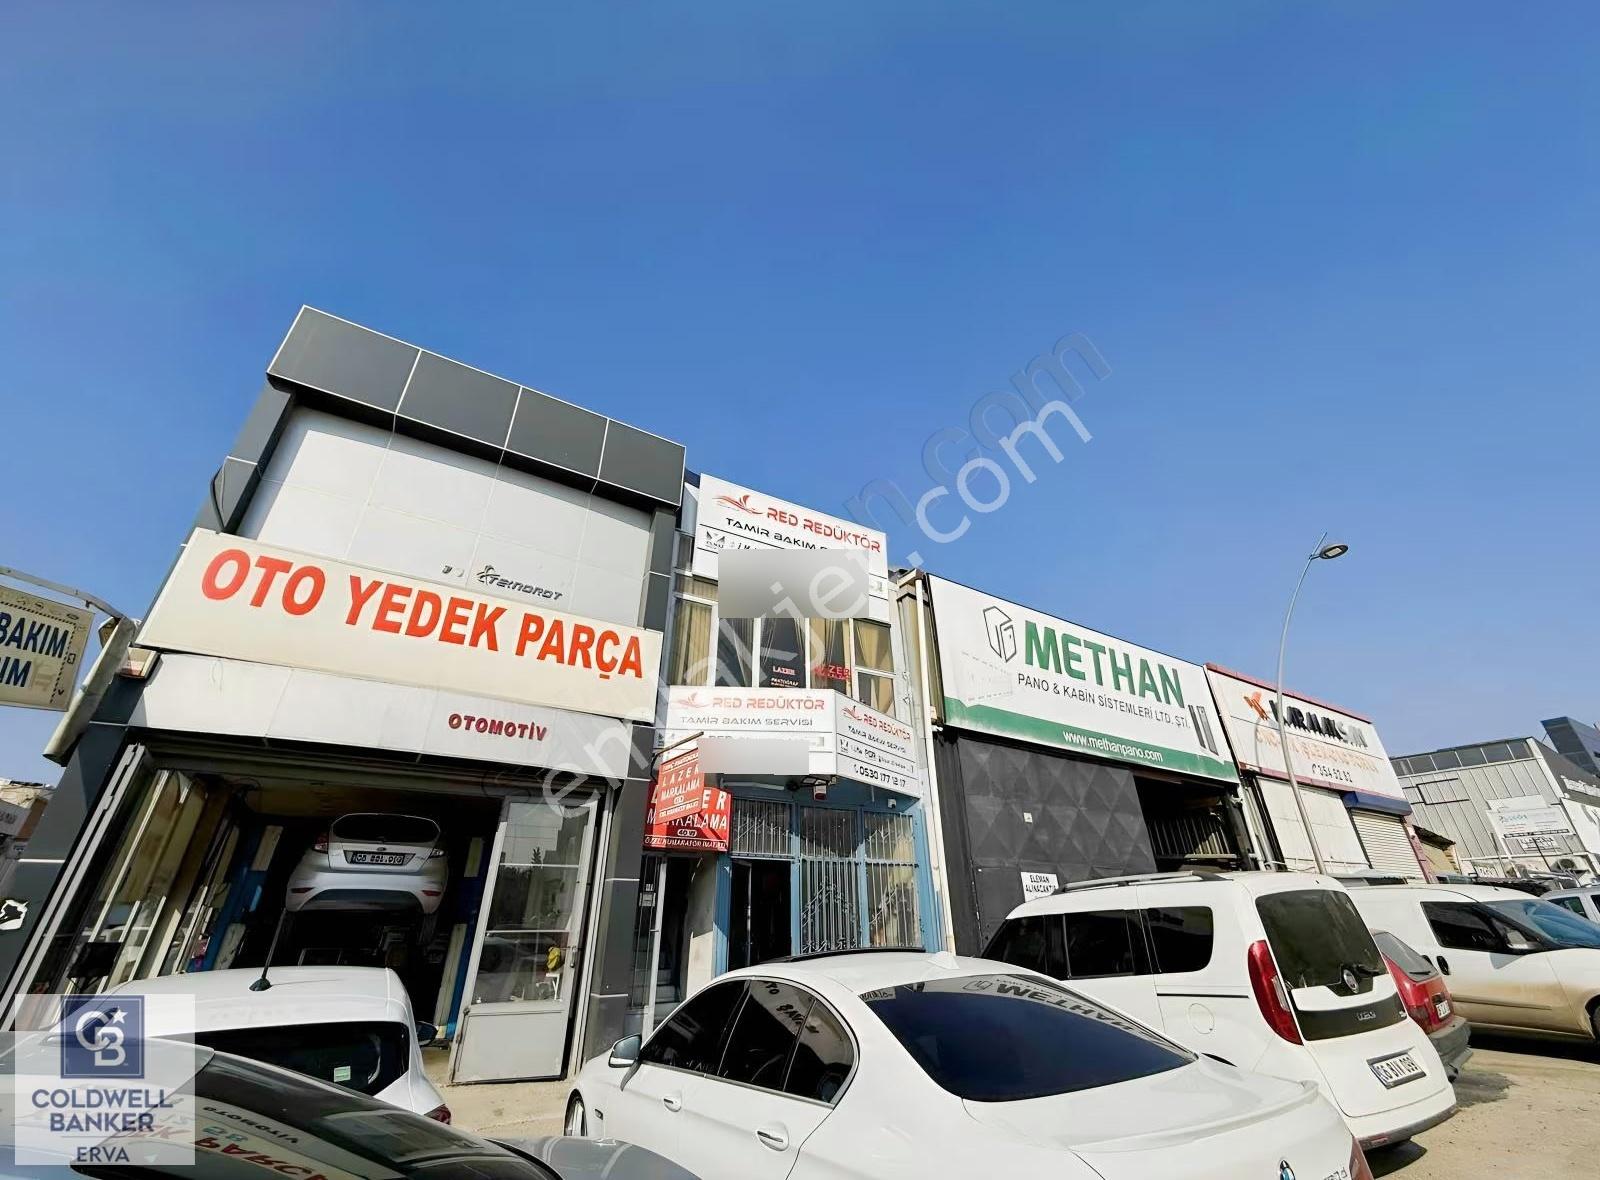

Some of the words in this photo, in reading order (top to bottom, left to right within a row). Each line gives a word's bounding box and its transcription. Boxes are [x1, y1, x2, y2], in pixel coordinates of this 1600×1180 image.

[767, 507, 798, 527] RED
[803, 518, 881, 553] REDÜKTÖR
[201, 549, 326, 616] OTO
[345, 575, 505, 652] YEDEK
[515, 612, 644, 680] PARÇA
[1025, 620, 1185, 708] METHAN
[713, 698, 742, 709] RED
[746, 695, 825, 710] REDÜKTÖR
[1018, 673, 1050, 693] PANO
[1053, 682, 1061, 695] &
[1063, 686, 1095, 705] KABİN
[1098, 693, 1153, 720] SİSTEMLERİ
[1155, 713, 1174, 725] LTD.
[449, 713, 547, 742] OTOMOTİV
[722, 717, 762, 726] BAKIM
[1062, 730, 1164, 762] www.methanpano.com
